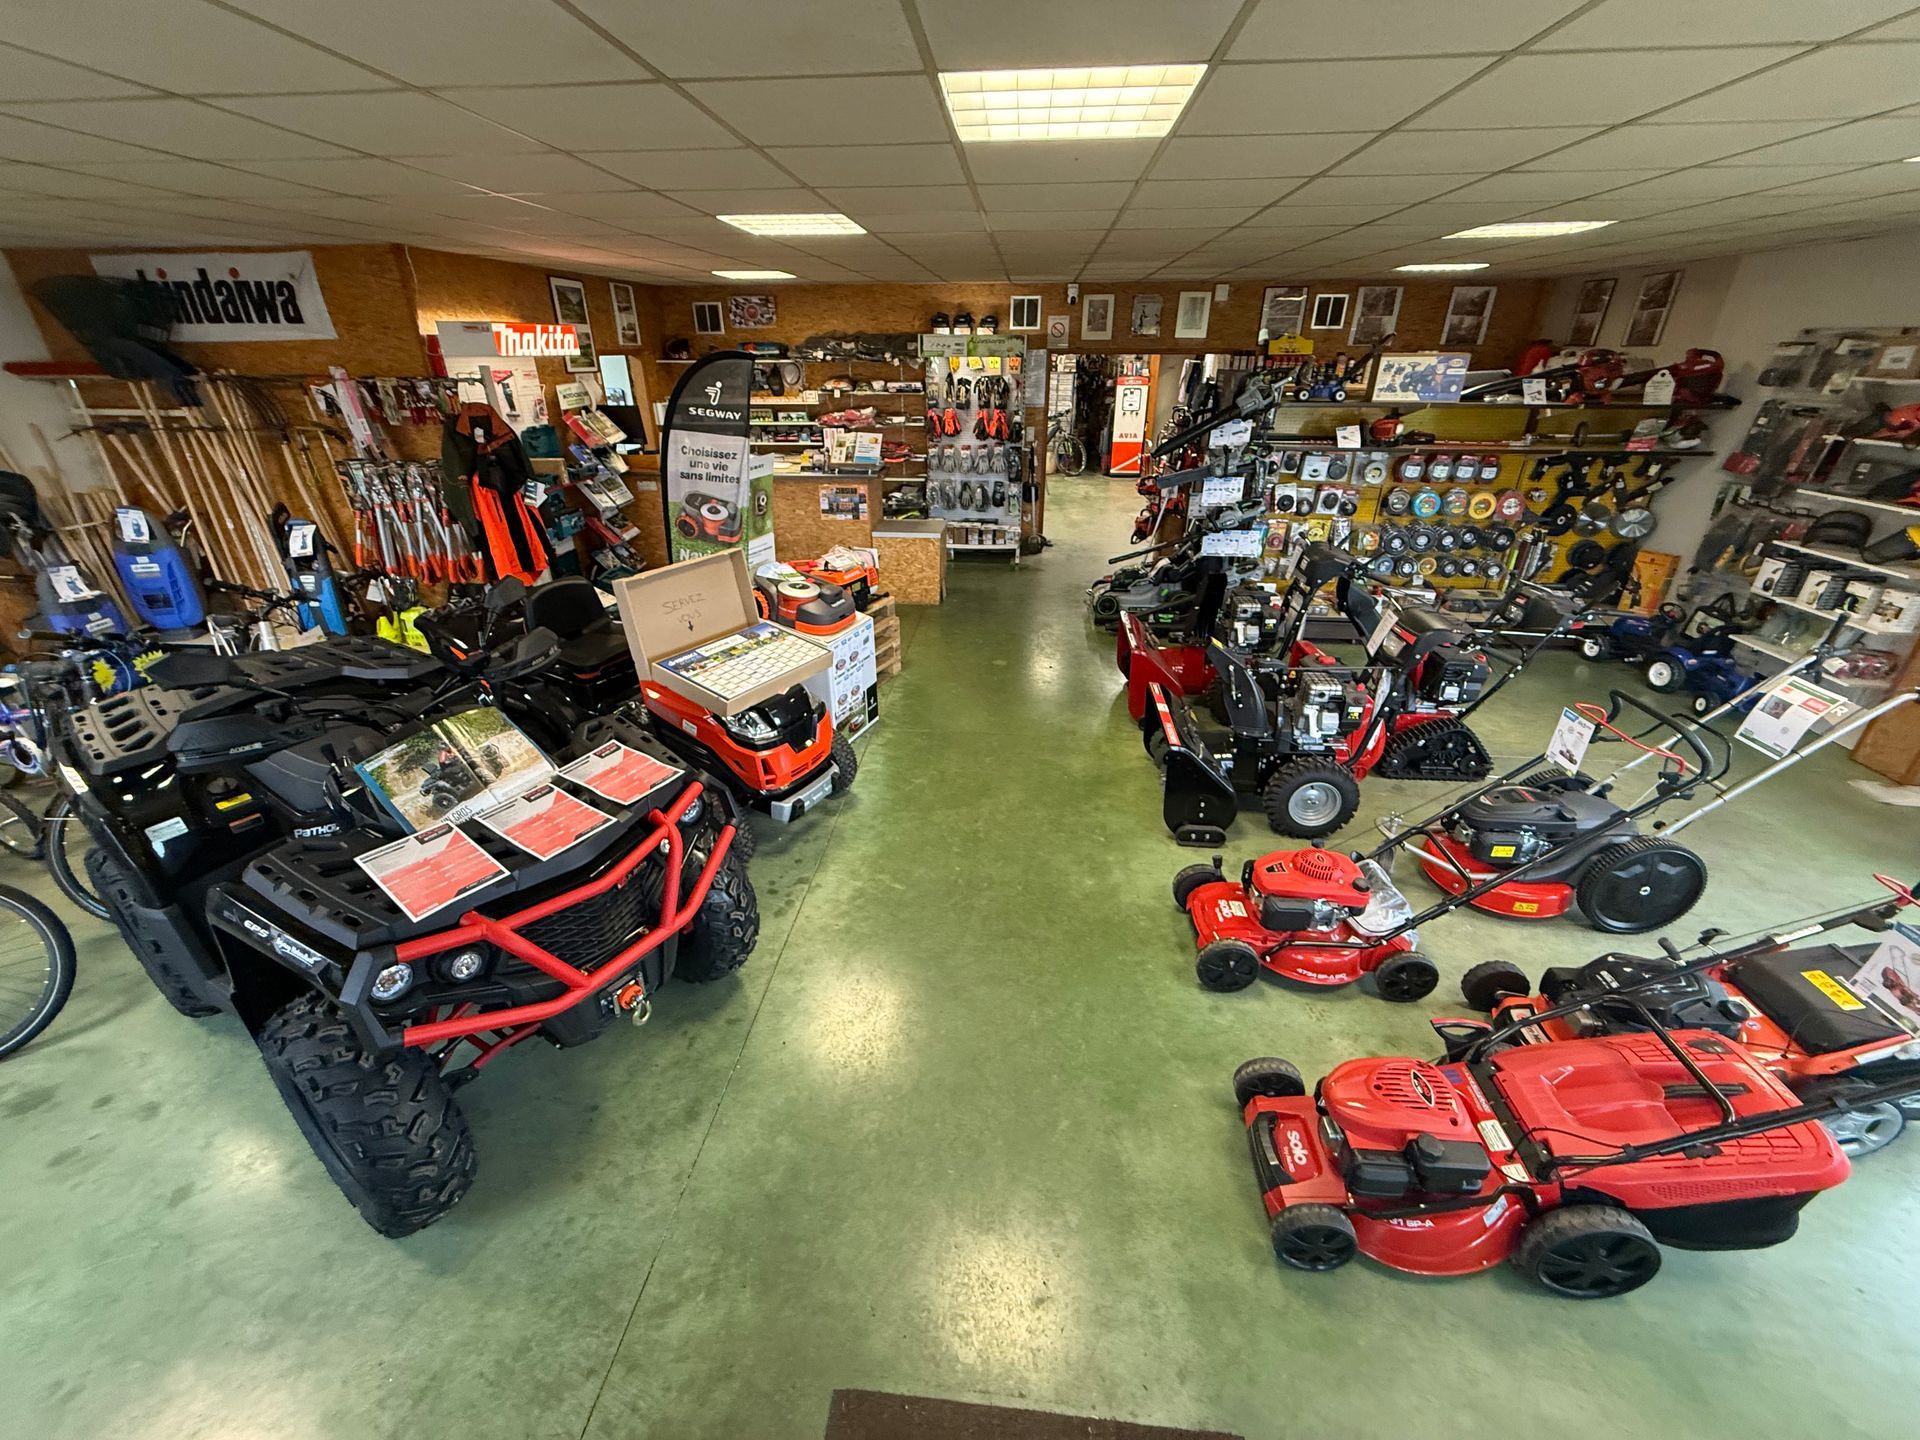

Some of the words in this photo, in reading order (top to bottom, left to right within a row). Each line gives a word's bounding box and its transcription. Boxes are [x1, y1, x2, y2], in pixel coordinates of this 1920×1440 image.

[688, 406, 742, 421] SEGWAY
[681, 445, 738, 460] Choisissez
[689, 460, 710, 470] une
[712, 461, 729, 471] vie
[680, 471, 703, 481] sans
[705, 471, 741, 484] limites
[243, 919, 271, 938] EPS
[1286, 1130, 1308, 1165] solo
